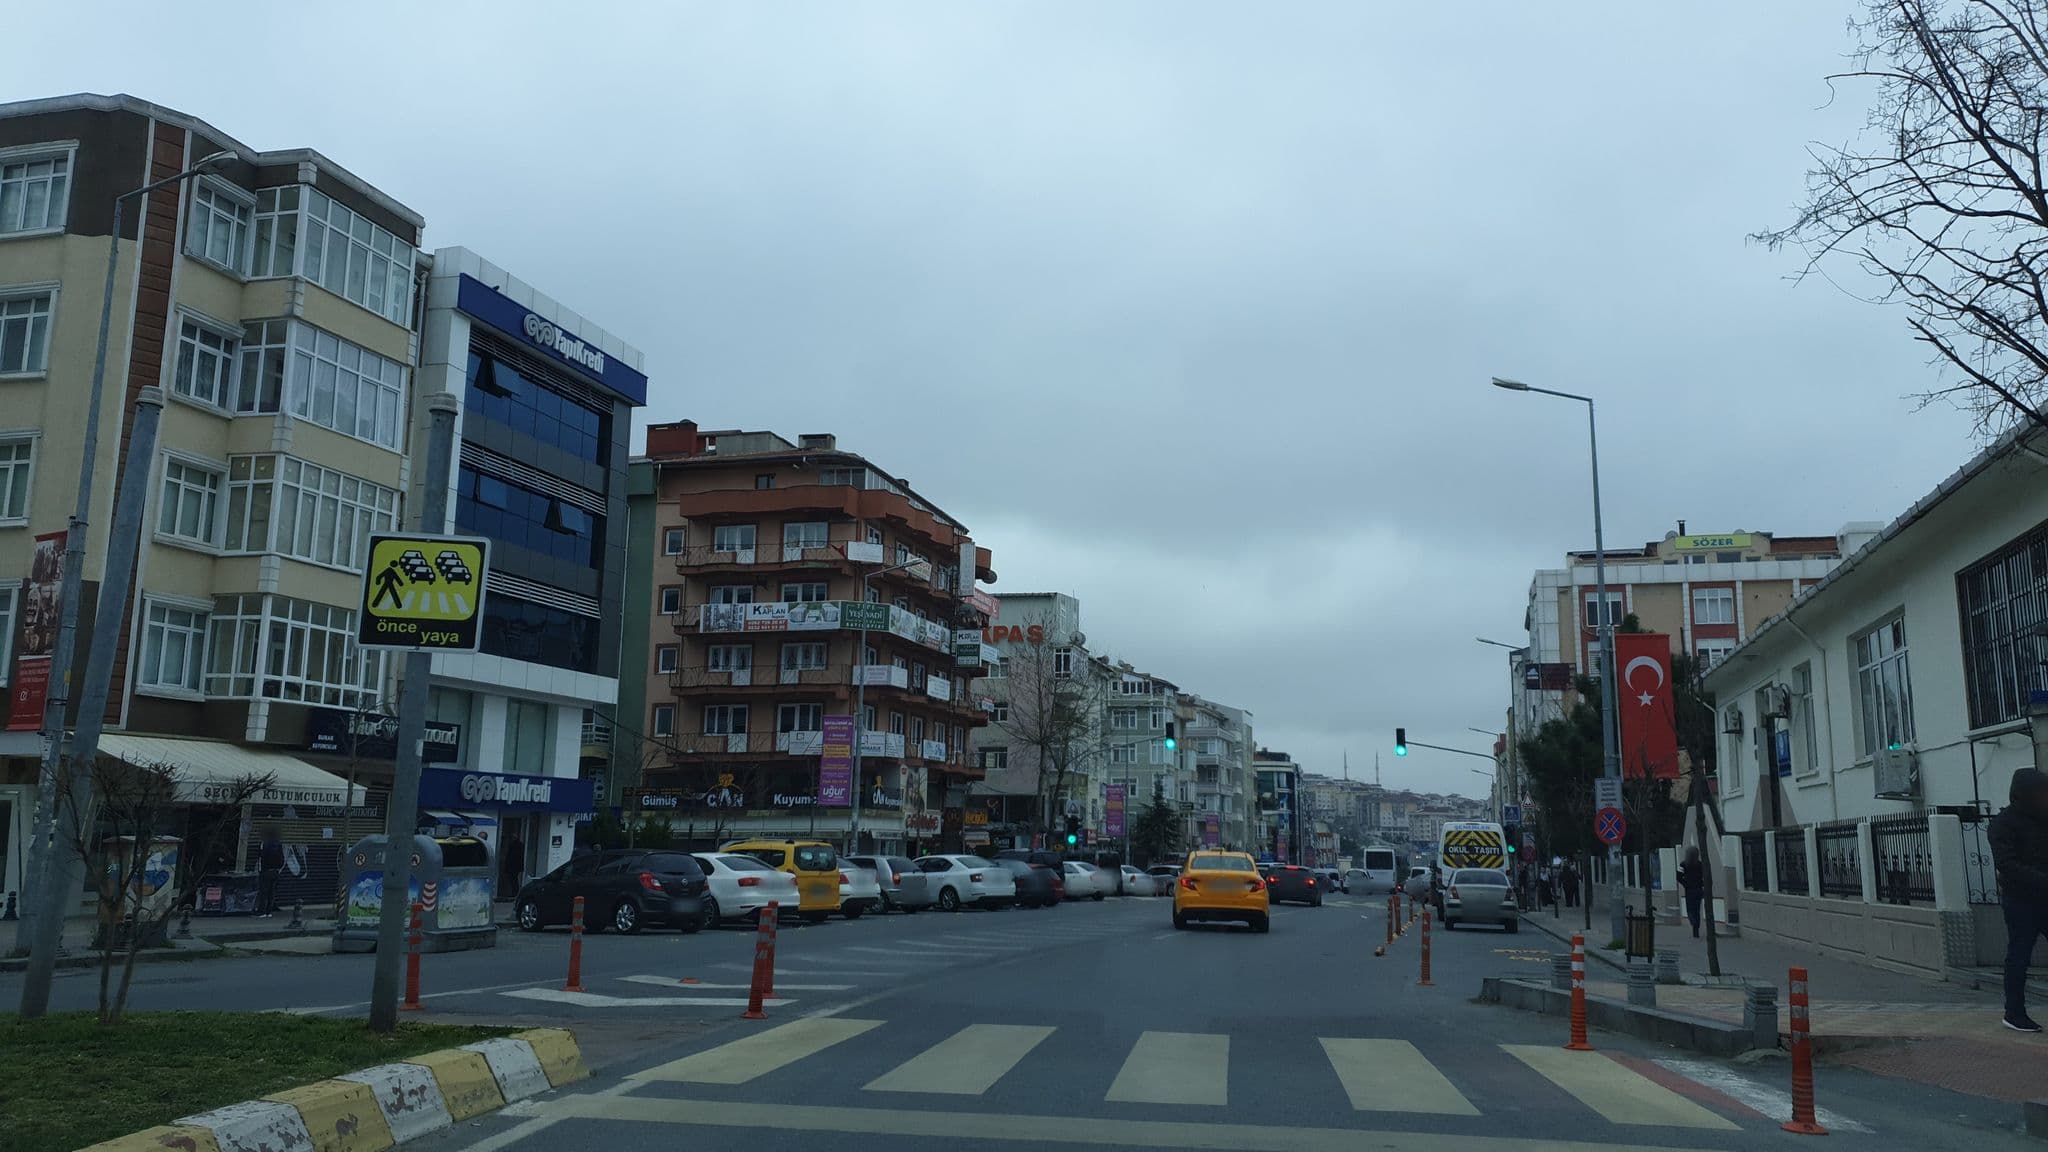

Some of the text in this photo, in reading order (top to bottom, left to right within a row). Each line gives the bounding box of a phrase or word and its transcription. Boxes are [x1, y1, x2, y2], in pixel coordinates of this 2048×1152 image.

[1693, 537, 1734, 547] SÖZER
[377, 619, 459, 645] önce yaya
[263, 790, 340, 803] KUYUMCULUK
[495, 776, 551, 805] YapıKredi
[822, 785, 846, 798] uğur
[642, 793, 678, 807] Gümüş
[1448, 846, 1500, 855] OKUL TAŞITI
